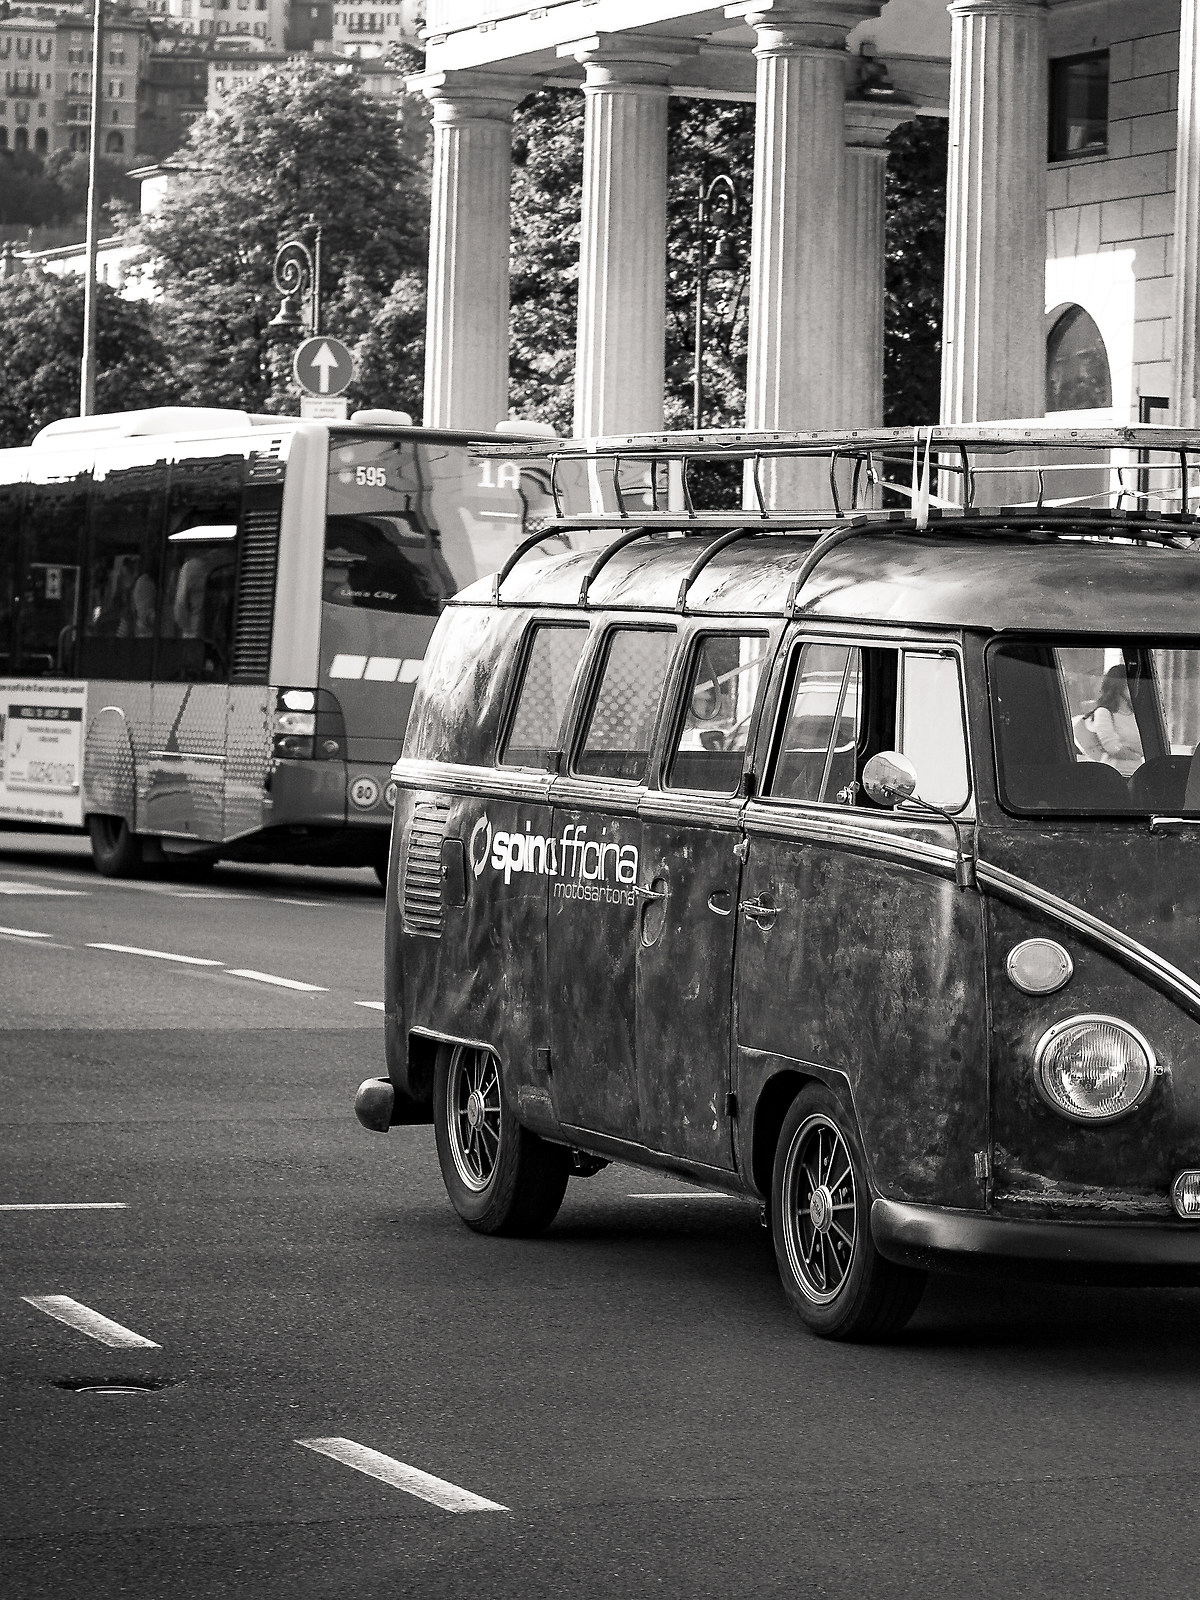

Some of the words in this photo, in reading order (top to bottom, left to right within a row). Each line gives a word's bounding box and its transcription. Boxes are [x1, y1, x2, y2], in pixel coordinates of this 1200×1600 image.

[356, 466, 387, 487] 595
[478, 460, 521, 490] 1A
[356, 785, 373, 800] 80
